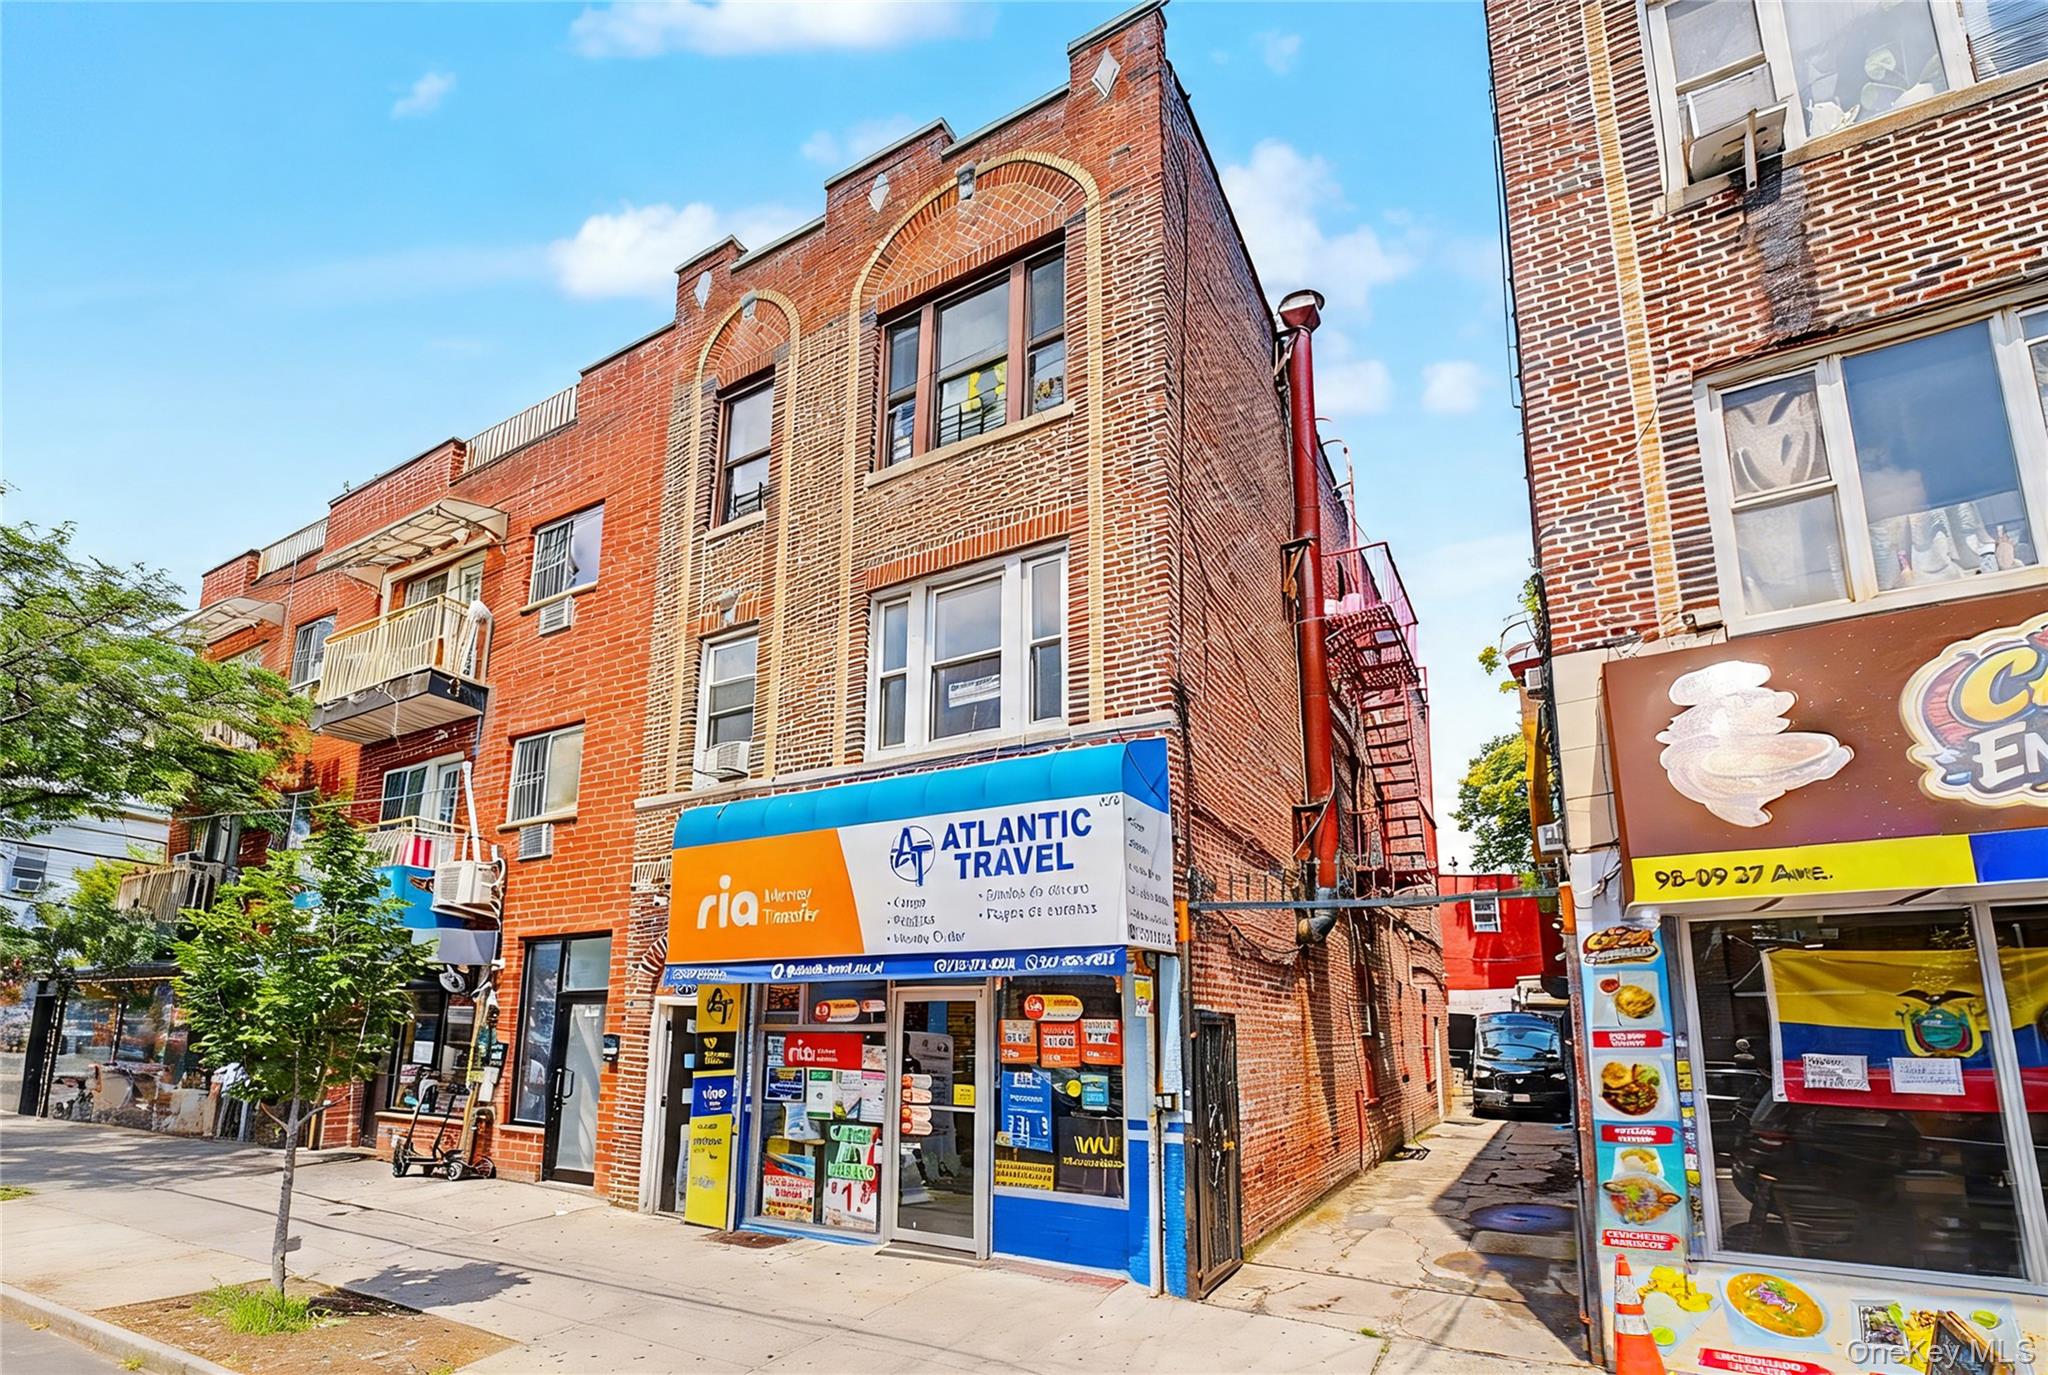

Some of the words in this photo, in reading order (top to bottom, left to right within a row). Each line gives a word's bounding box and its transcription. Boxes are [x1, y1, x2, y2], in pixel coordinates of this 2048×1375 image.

[941, 808, 1092, 851] ATLANTIC
[954, 842, 1074, 880] TRAVEL
[697, 874, 759, 929] ria
